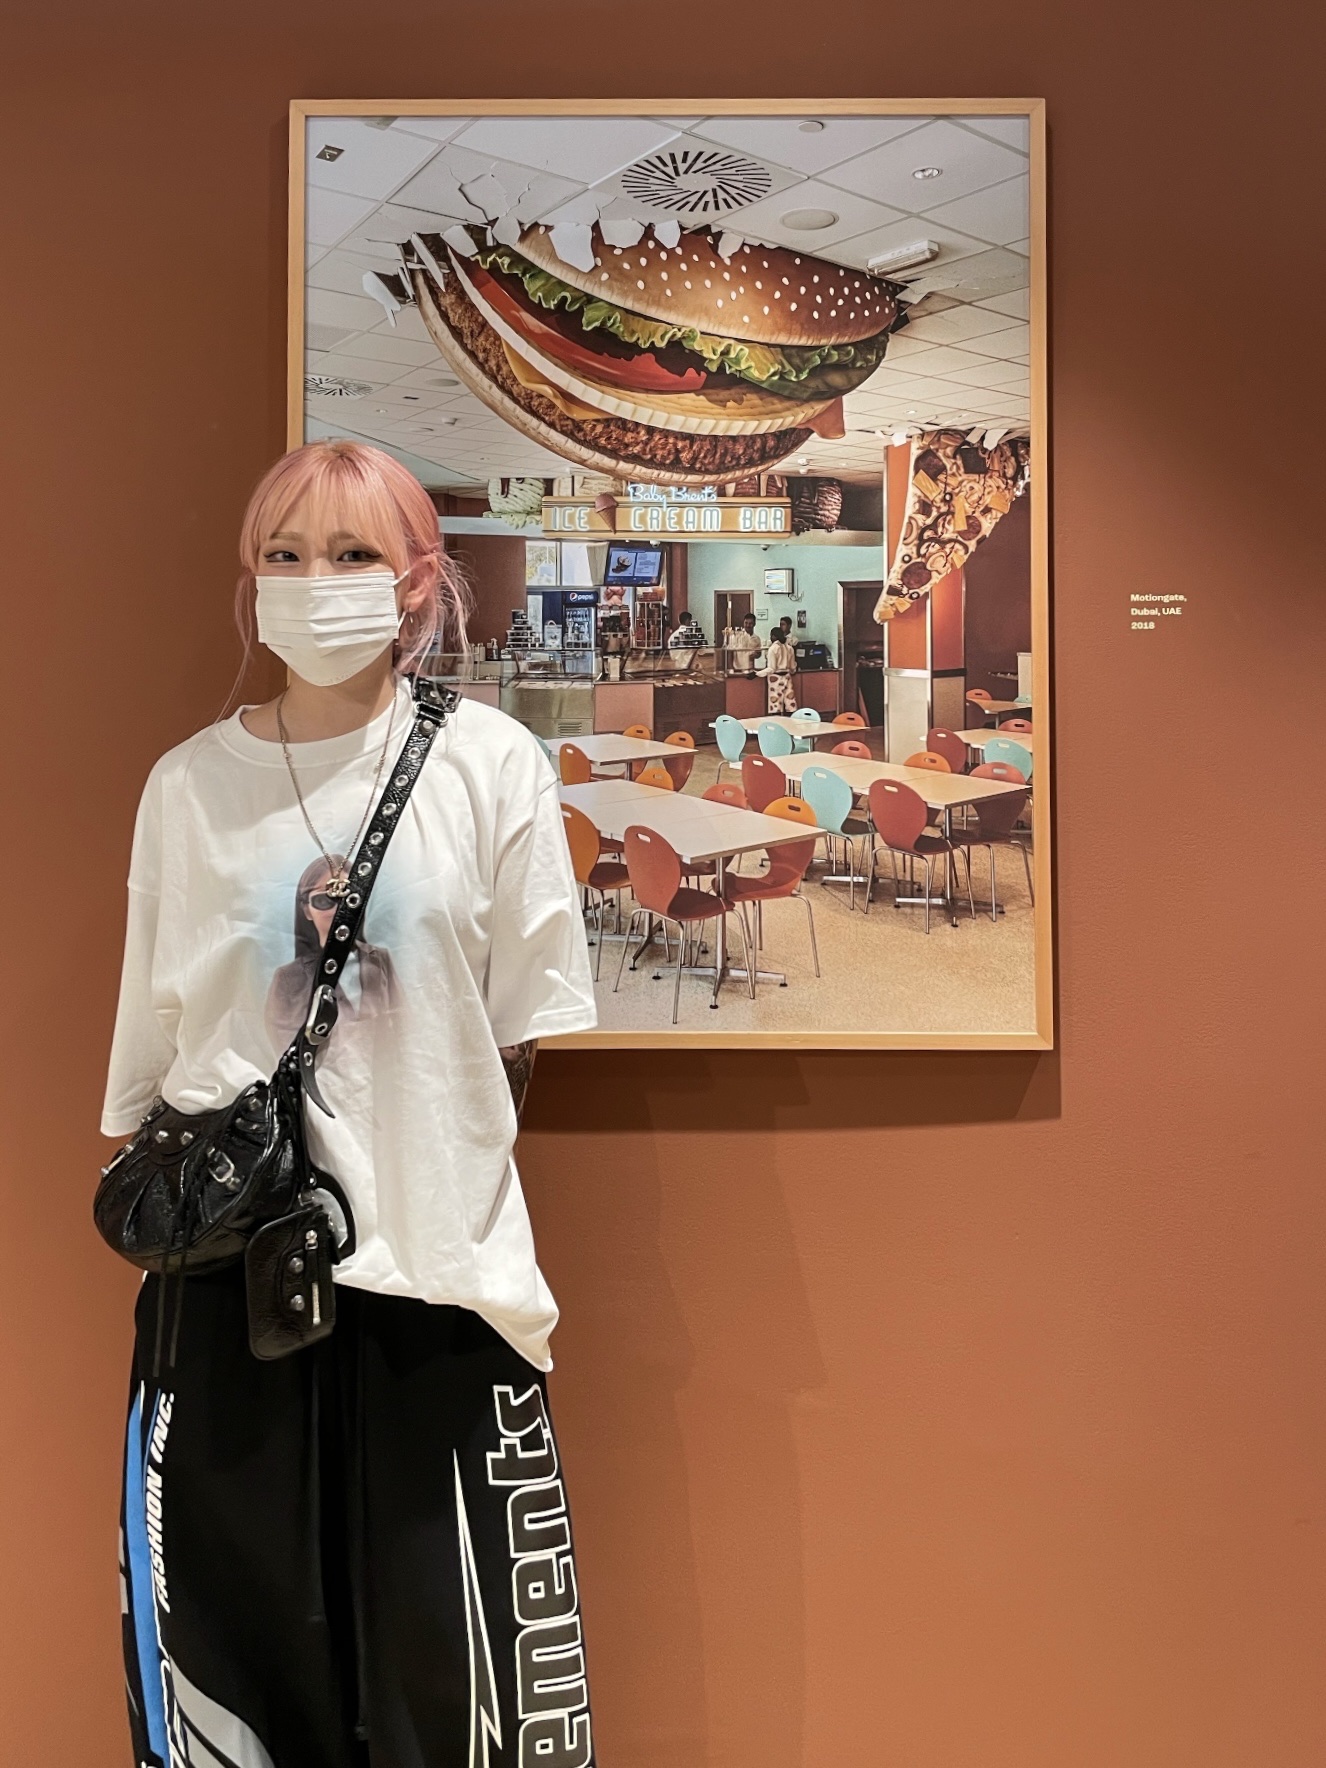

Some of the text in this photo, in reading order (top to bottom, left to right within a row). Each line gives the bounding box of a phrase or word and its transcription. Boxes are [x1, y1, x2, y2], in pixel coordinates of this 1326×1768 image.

[628, 484, 667, 512] Baby
[551, 506, 787, 532] ICE CREAM BAR
[1130, 593, 1188, 603] Motiongate,
[1130, 607, 1182, 616] Dubai, UAE
[1131, 621, 1155, 630] 2018
[146, 1392, 175, 1614] FASHION INC.
